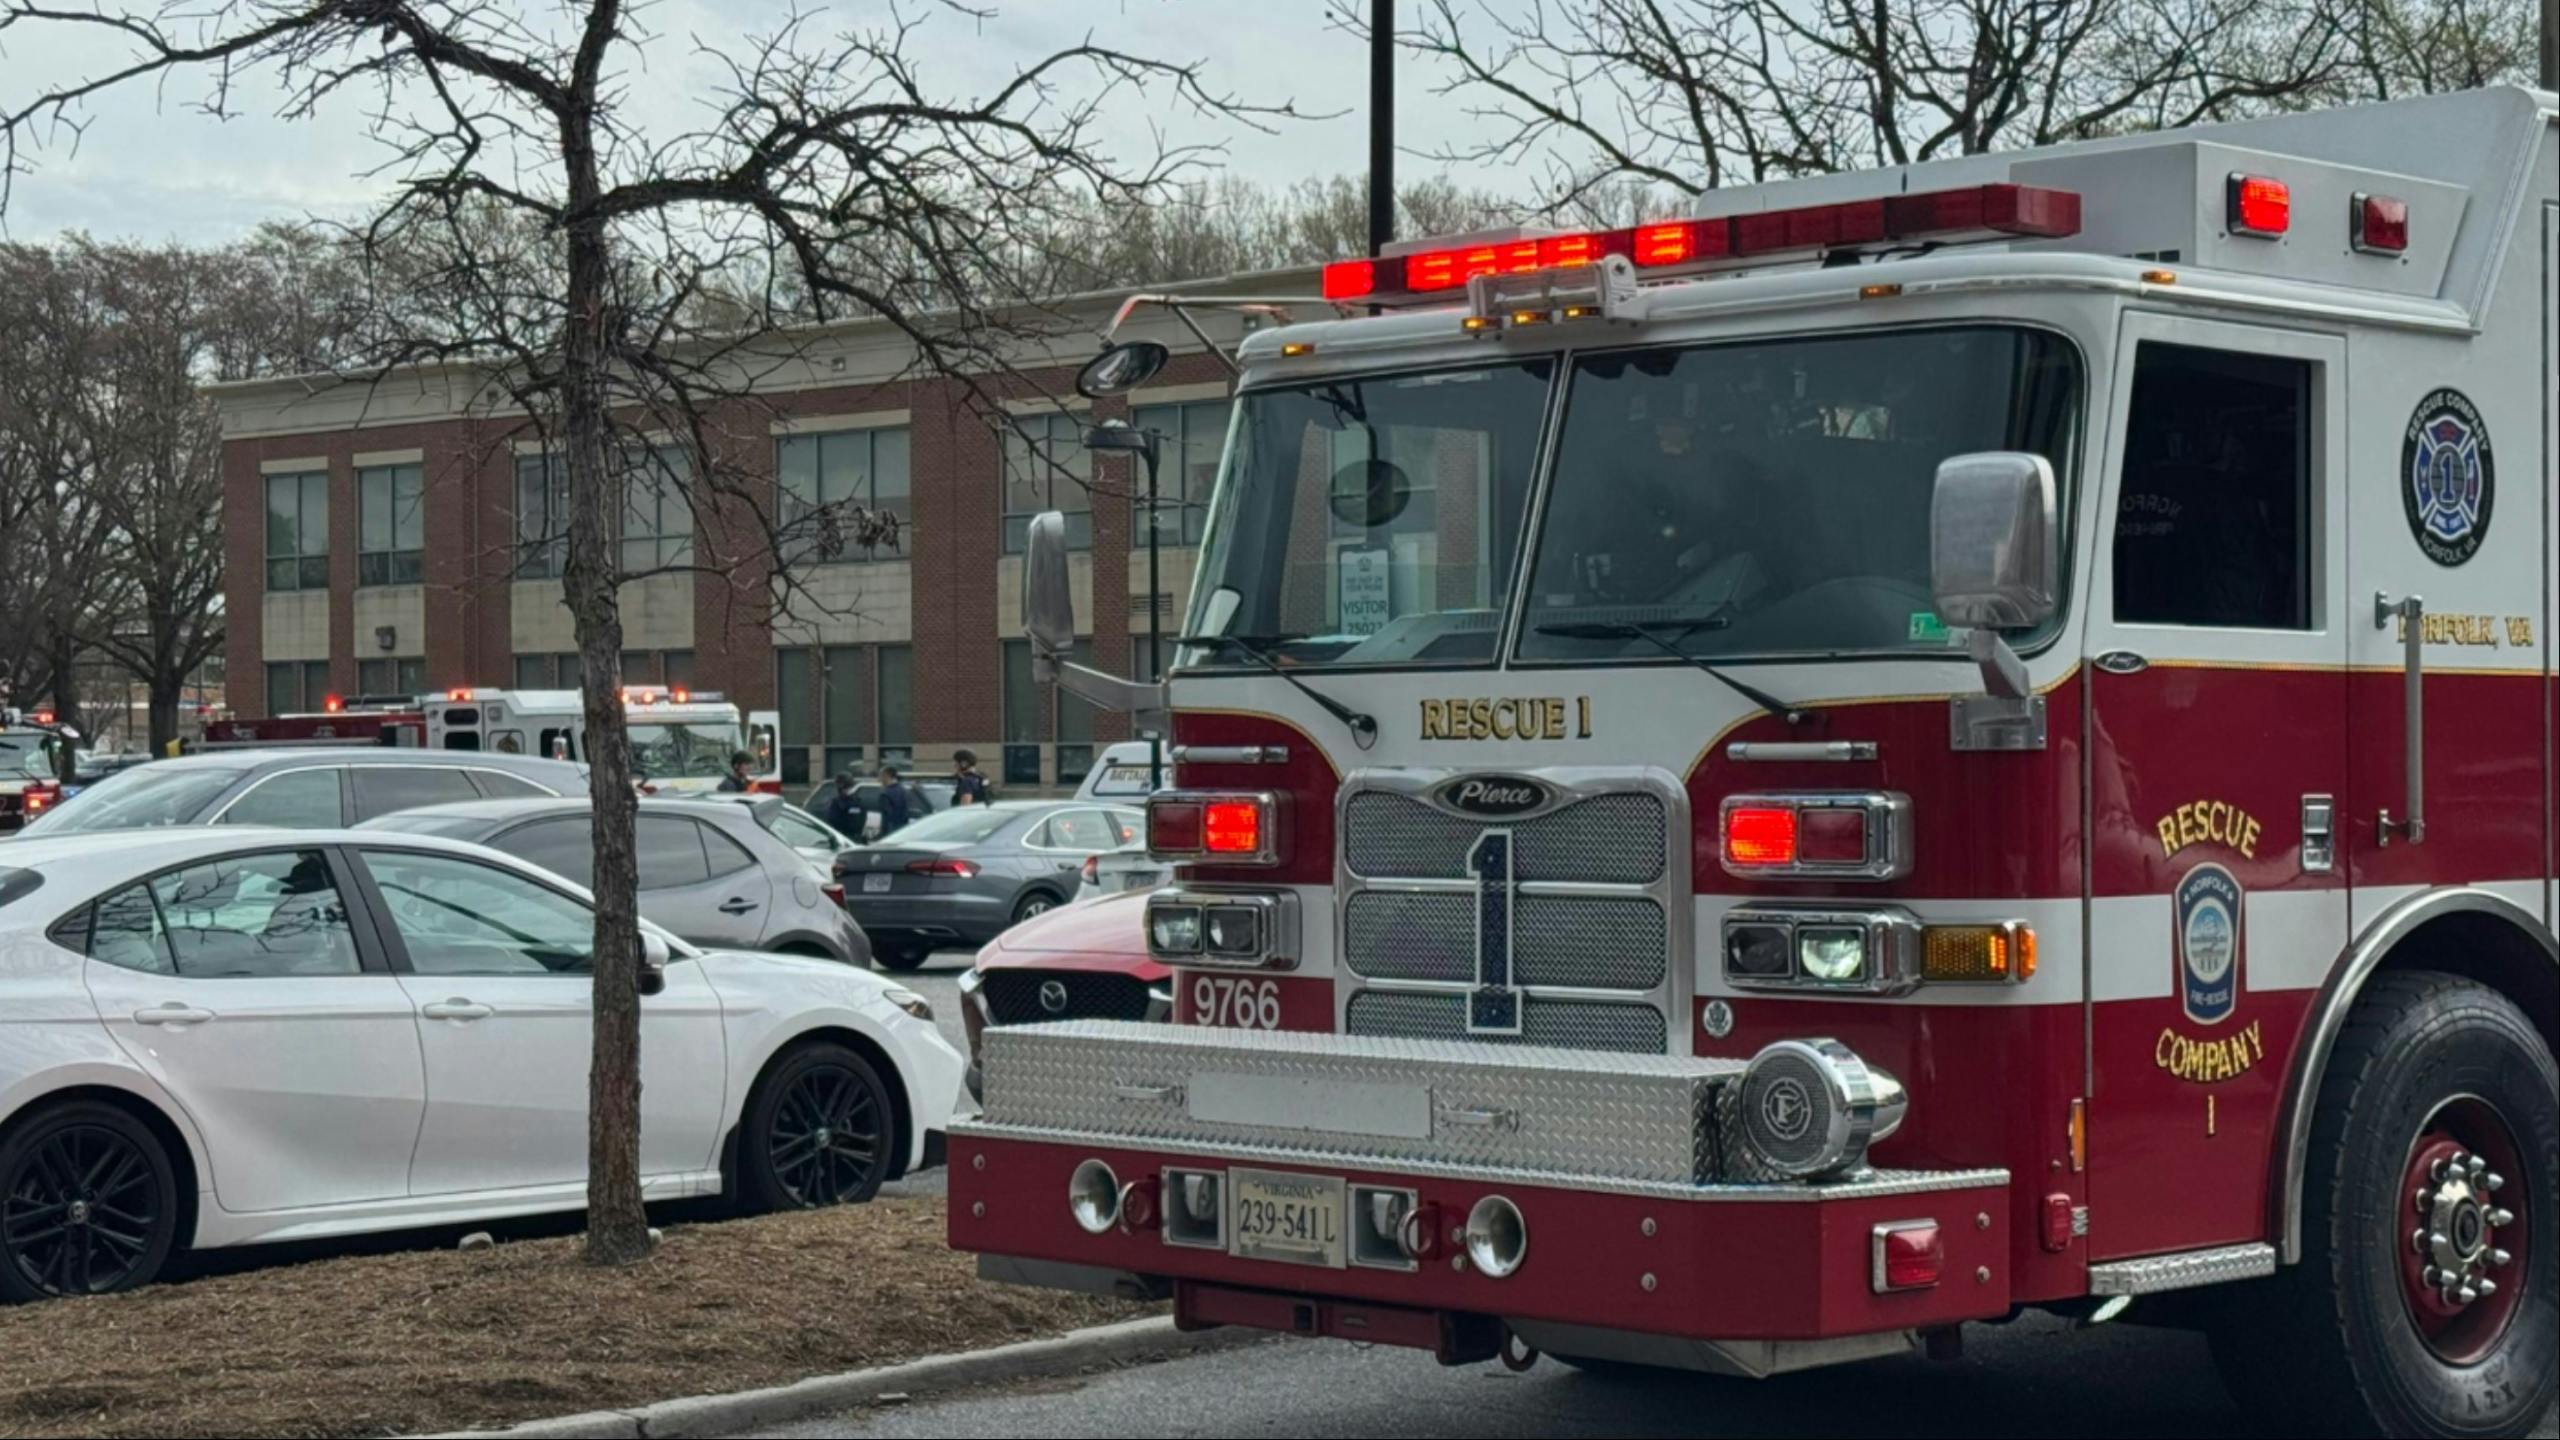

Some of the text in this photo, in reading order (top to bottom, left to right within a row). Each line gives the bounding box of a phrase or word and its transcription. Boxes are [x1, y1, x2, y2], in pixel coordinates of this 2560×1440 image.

[2408, 392, 2489, 452] RESCUE COMPANY
[2438, 452, 2457, 504] 1
[1343, 600, 1387, 614] VISITOR
[2505, 616, 2534, 647] VA
[1420, 696, 1593, 741] RESCUE 1
[1458, 780, 1532, 807] Pierce
[2157, 800, 2262, 859] RESCUE
[2189, 875, 2229, 896] NORFOLK
[1466, 829, 1522, 1034] 1
[1194, 976, 1280, 1030] 9766
[2155, 1020, 2263, 1082] COMPANY
[1262, 1182, 1315, 1199] VIRGINIA
[1240, 1198, 1336, 1243] 239-541L
